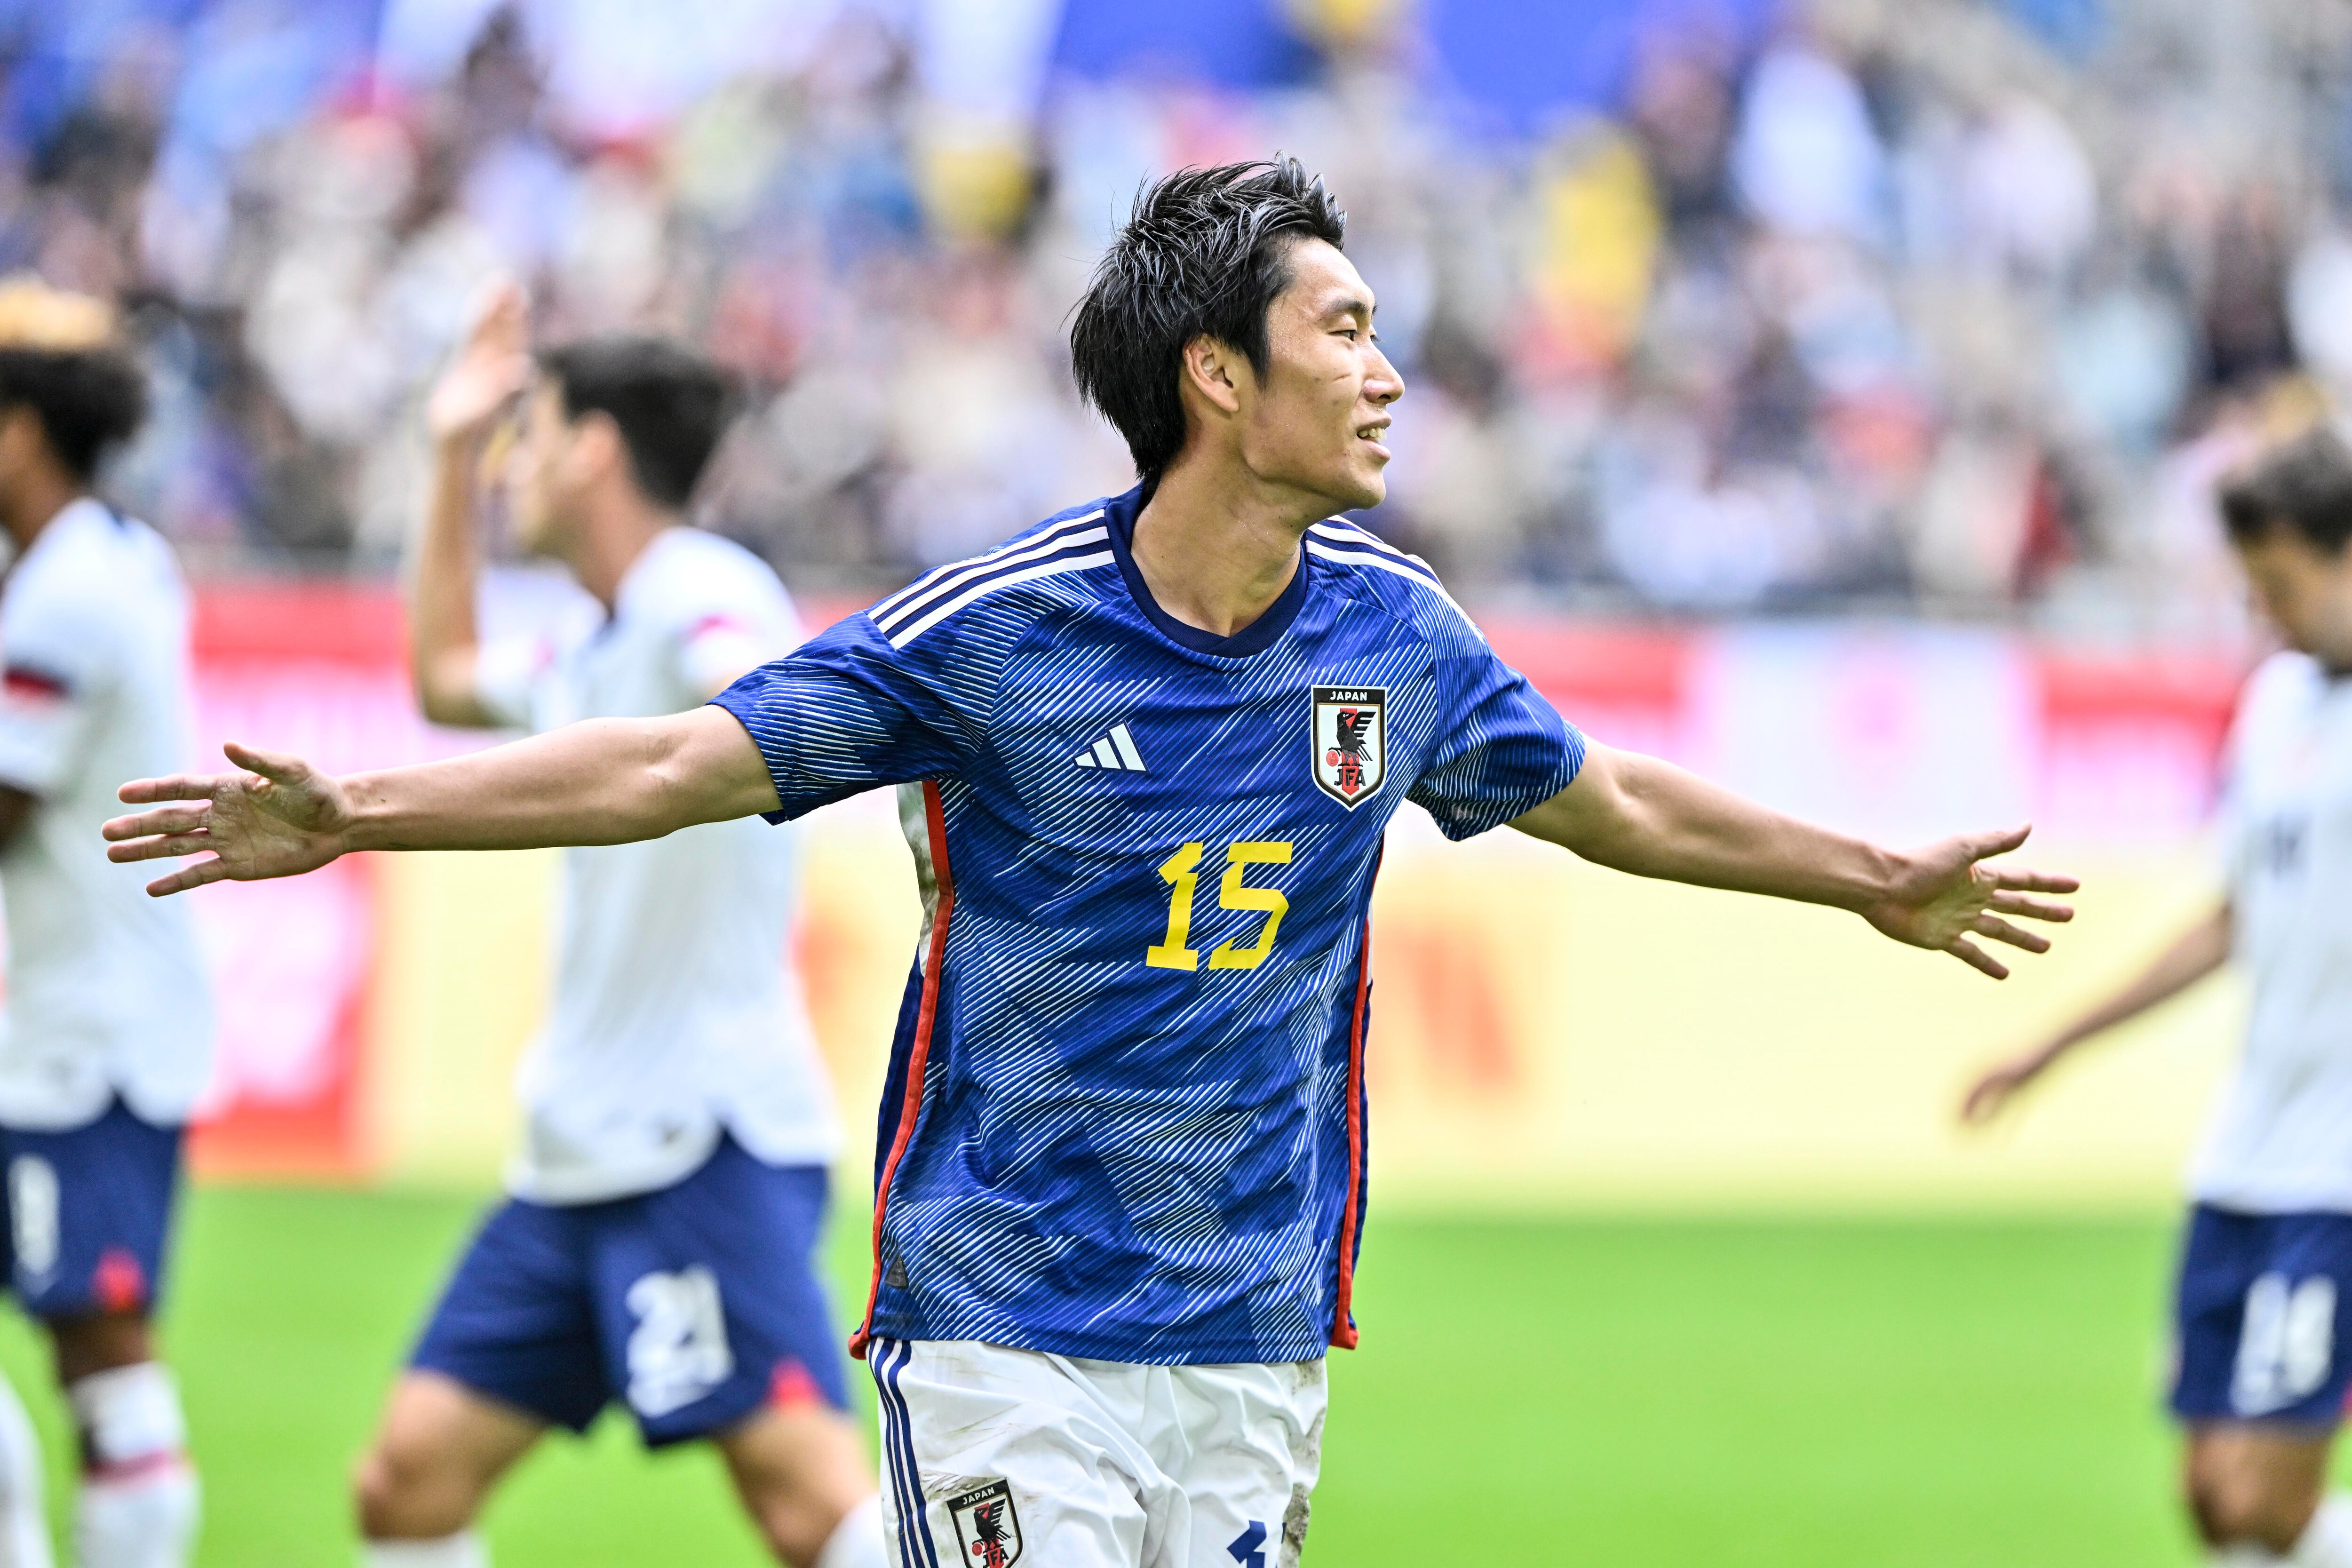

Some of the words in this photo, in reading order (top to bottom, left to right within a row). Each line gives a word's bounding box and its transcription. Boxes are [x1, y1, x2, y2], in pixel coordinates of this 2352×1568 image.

[1330, 691, 1367, 701] JAPAN
[1334, 768, 1366, 786] JFA
[1146, 841, 1293, 971] 15
[963, 1487, 995, 1505] JAPAN
[983, 1547, 1009, 1568] JFA
